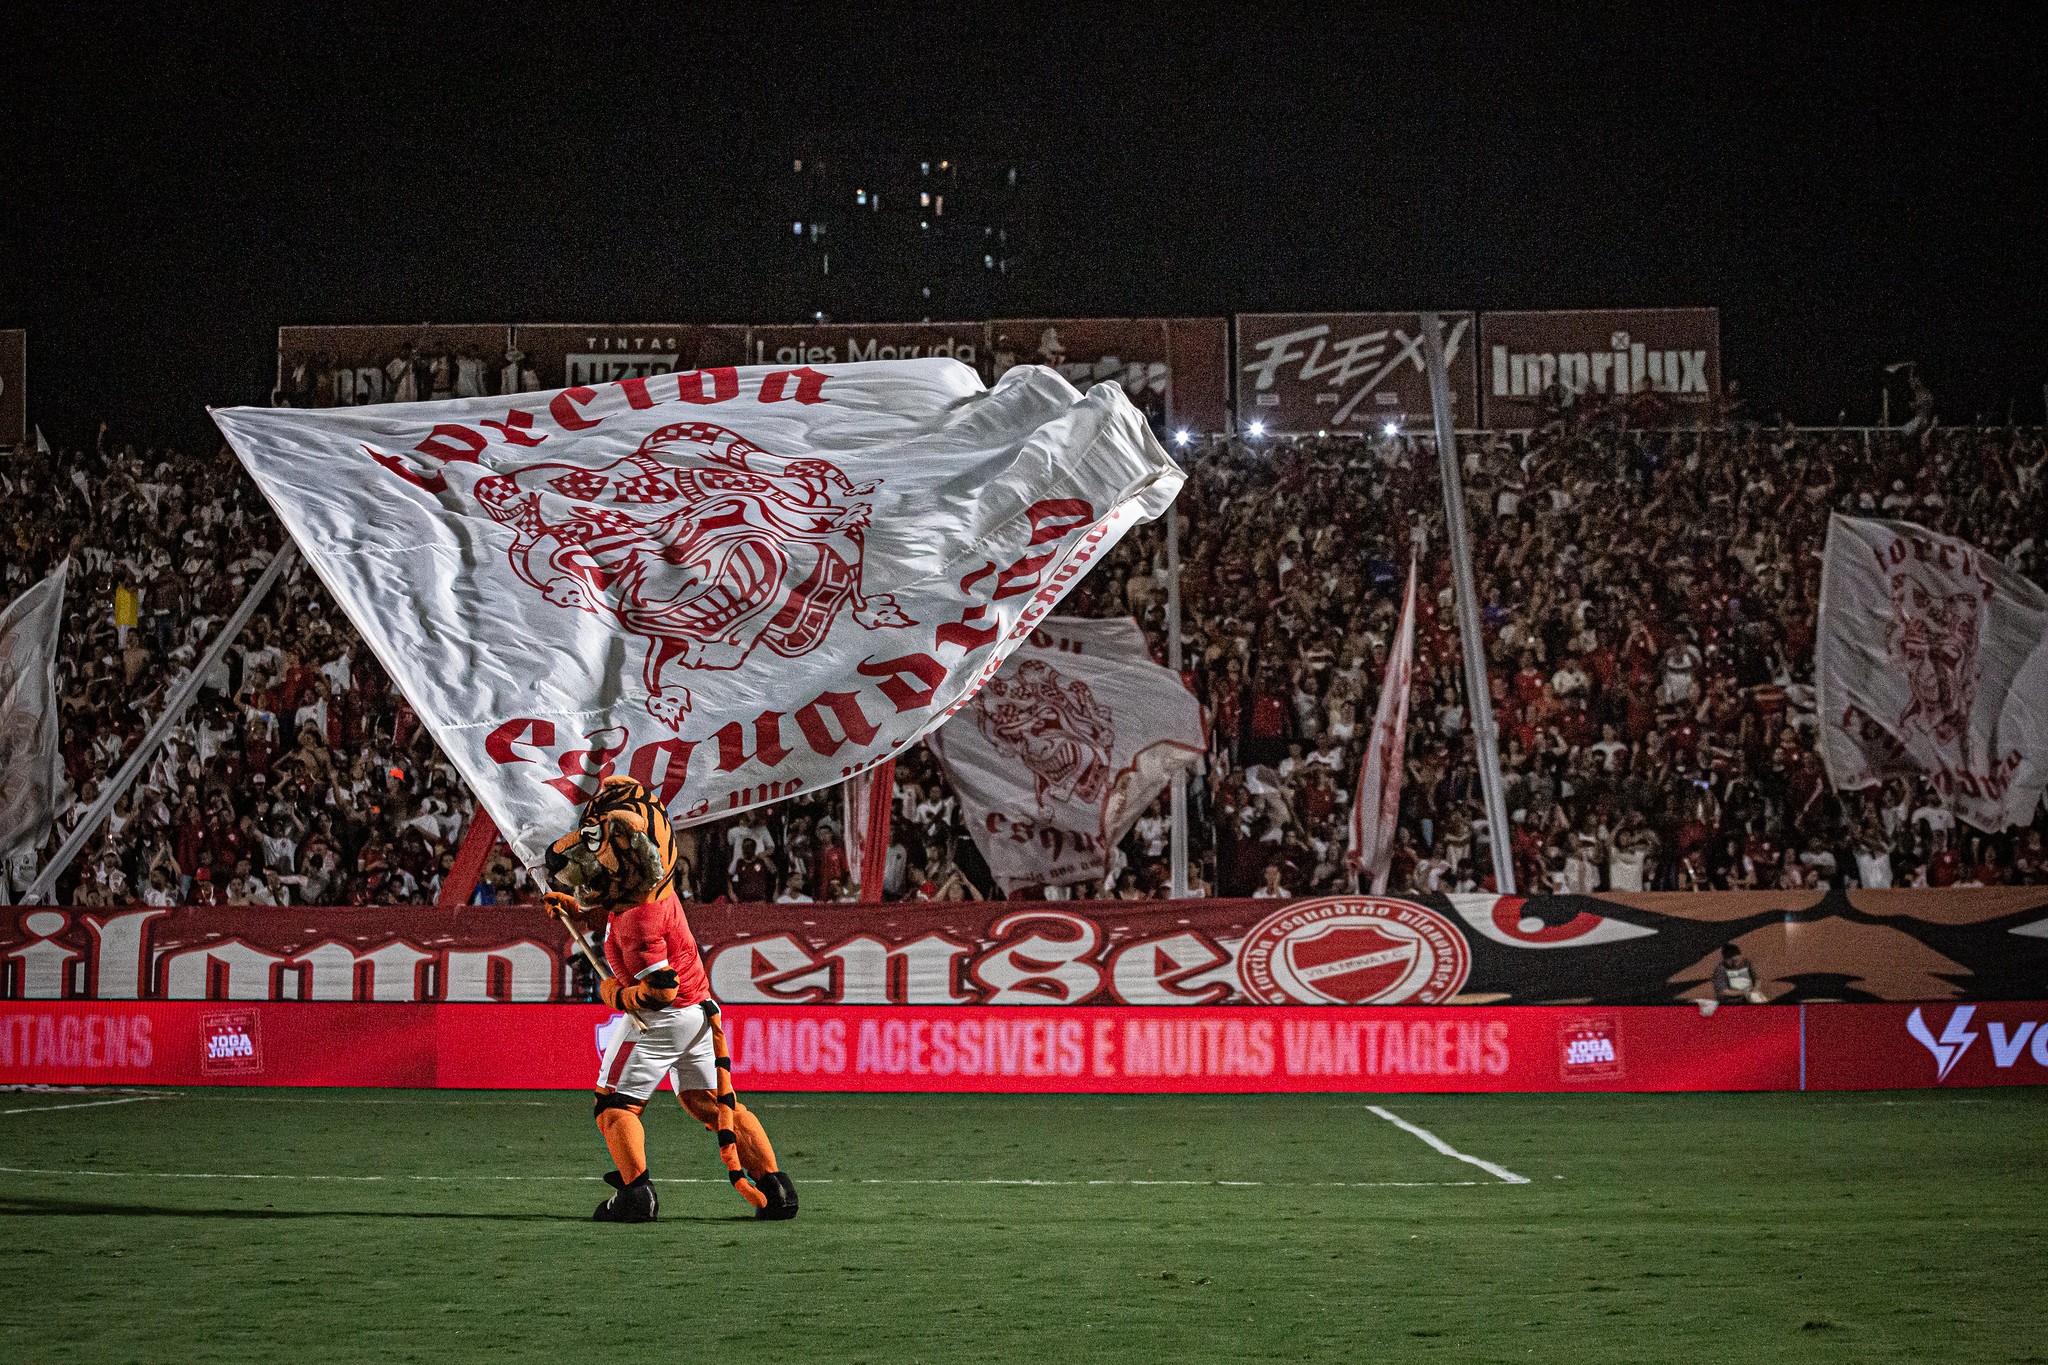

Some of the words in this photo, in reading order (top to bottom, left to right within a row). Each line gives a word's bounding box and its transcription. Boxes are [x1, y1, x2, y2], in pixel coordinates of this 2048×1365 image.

[587, 337, 678, 350] TINTAS
[1492, 331, 1710, 397] Imprilux
[208, 1033, 252, 1048] JOGA
[722, 1018, 847, 1074] LANOS
[1093, 1019, 1116, 1076] E
[1124, 1019, 1275, 1077] MUITAS
[1284, 1019, 1510, 1077] VANTAGENS
[208, 1045, 253, 1059] JUNTO
